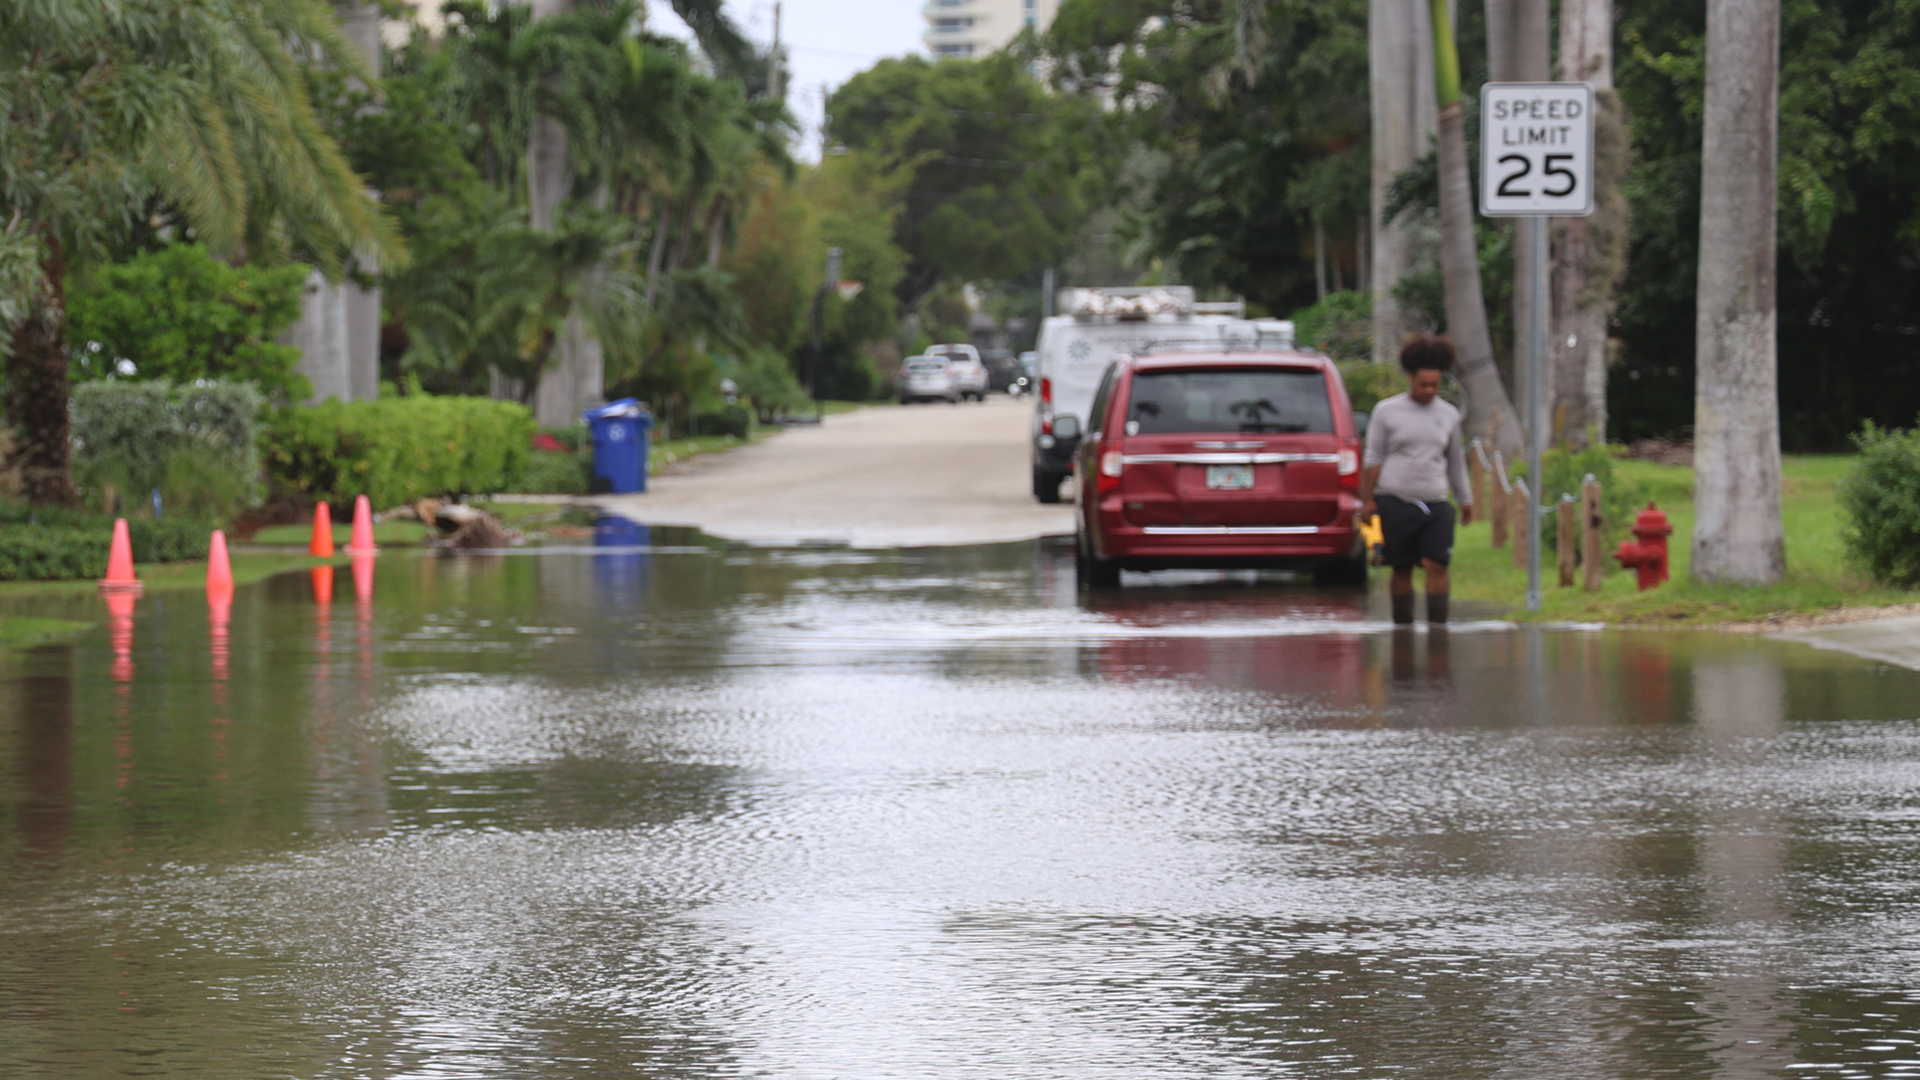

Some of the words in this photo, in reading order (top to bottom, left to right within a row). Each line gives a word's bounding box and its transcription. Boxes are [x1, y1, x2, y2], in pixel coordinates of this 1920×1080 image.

[1494, 100, 1583, 119] SPEED
[1502, 126, 1571, 145] LIMIT
[1496, 154, 1577, 197] 25
